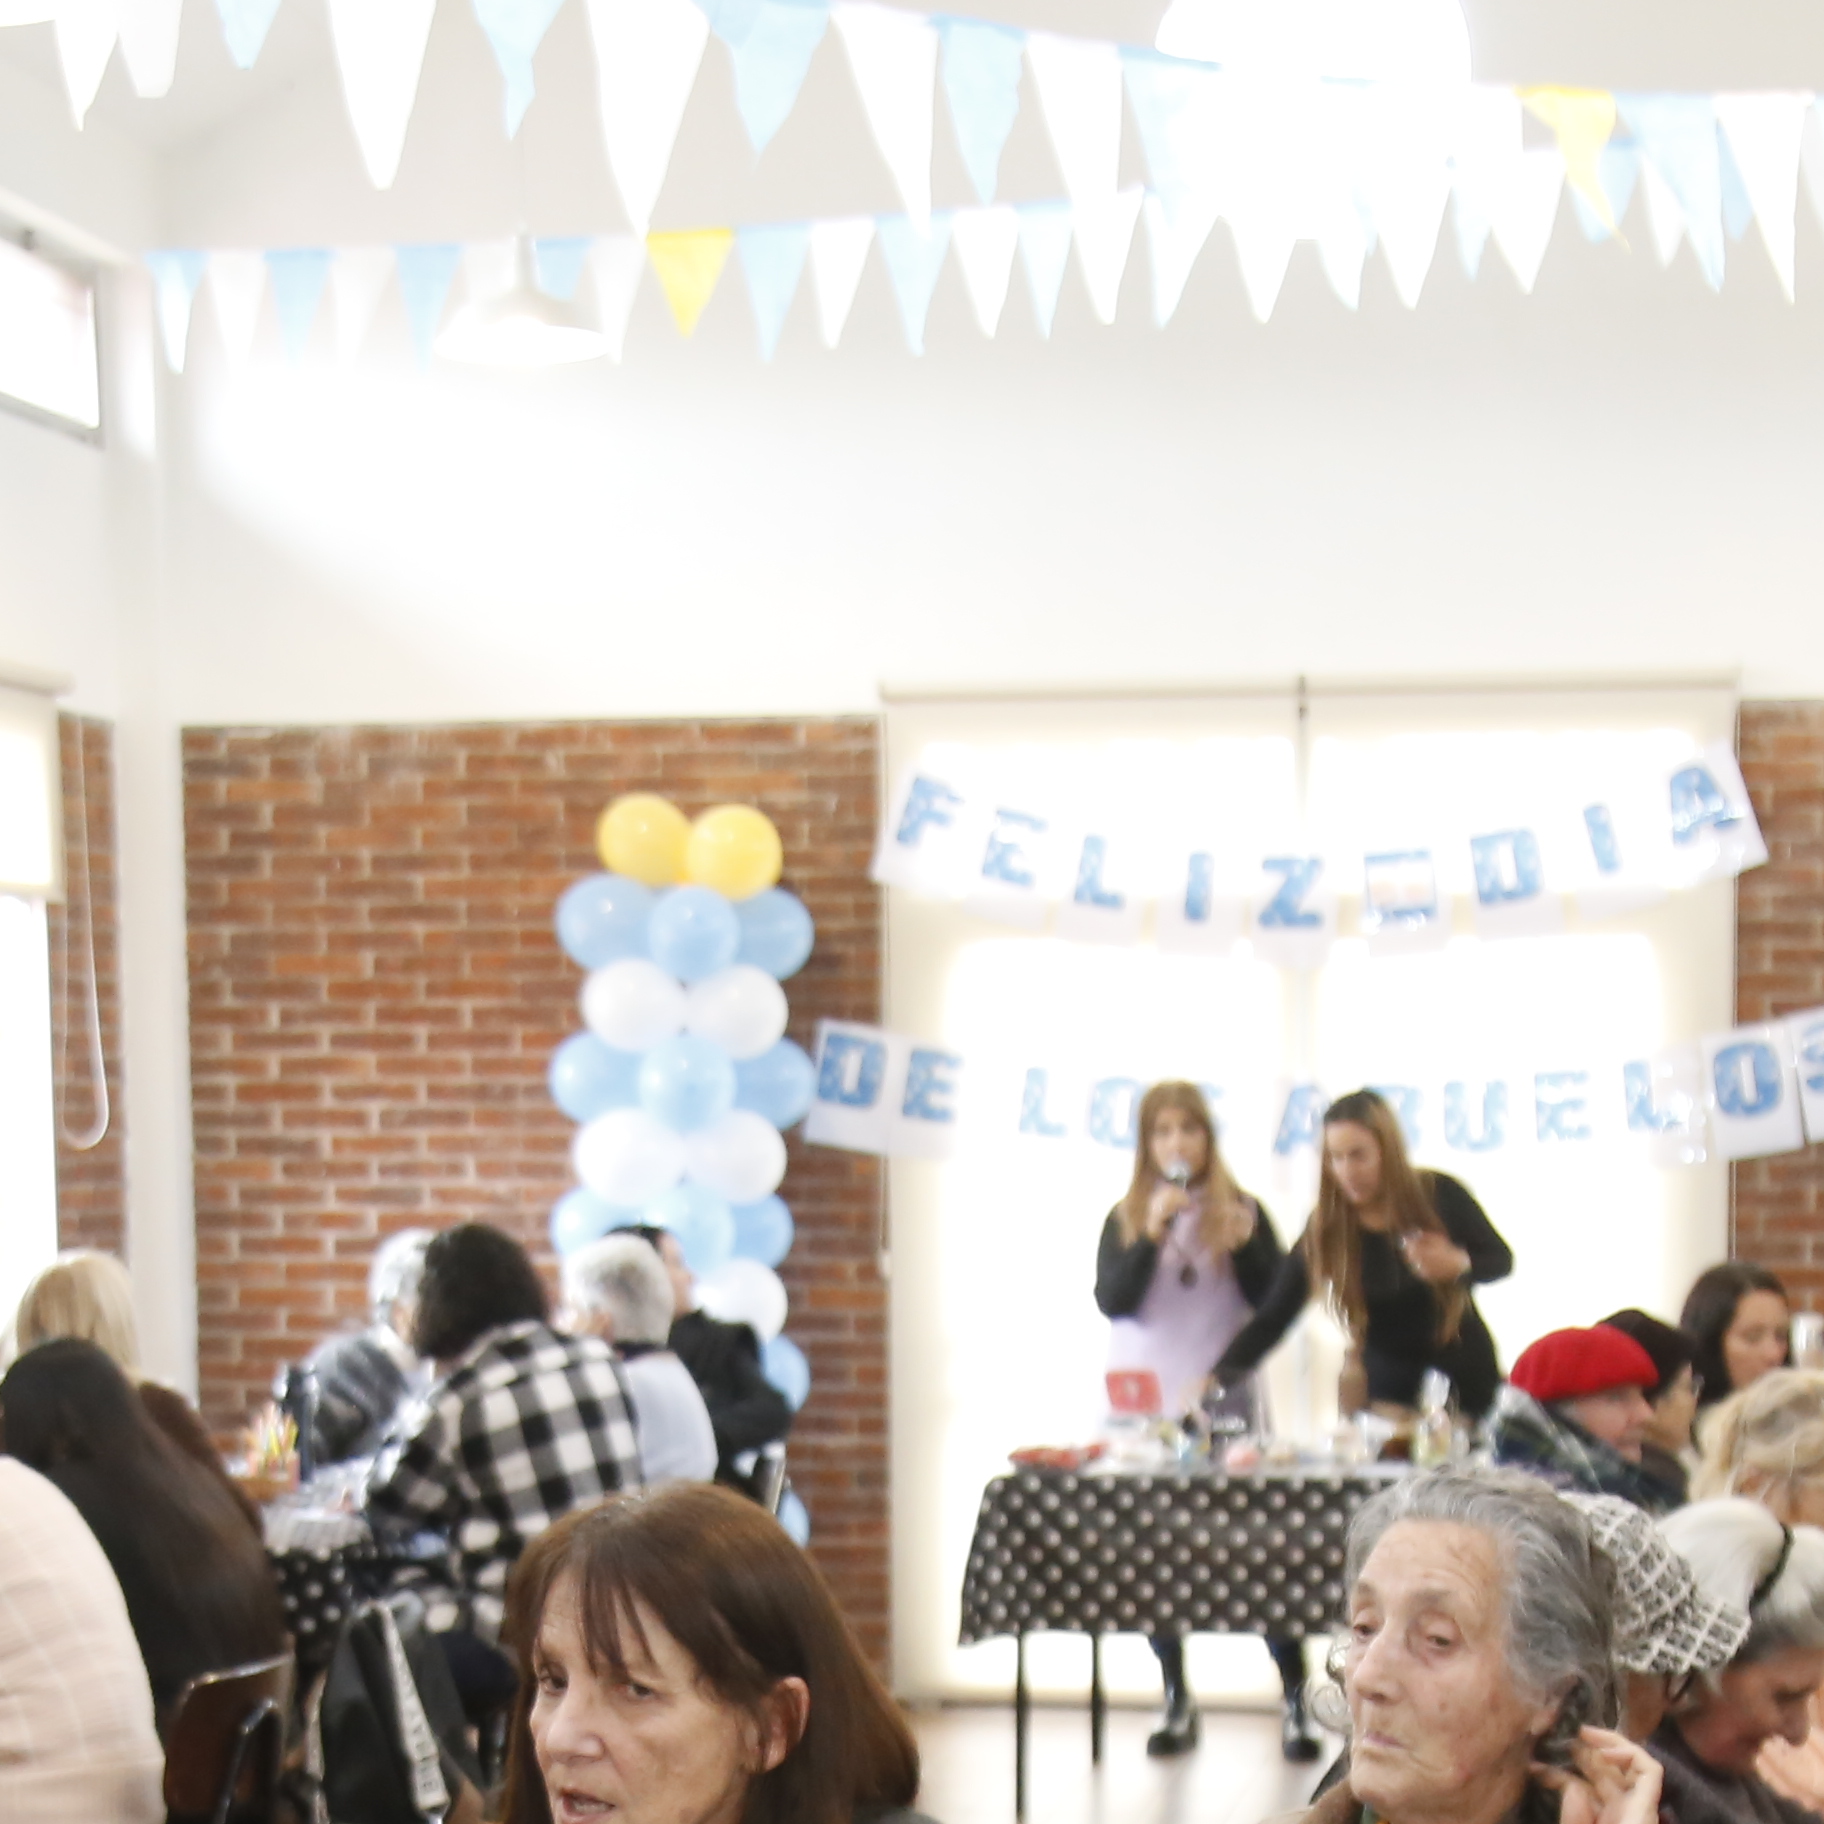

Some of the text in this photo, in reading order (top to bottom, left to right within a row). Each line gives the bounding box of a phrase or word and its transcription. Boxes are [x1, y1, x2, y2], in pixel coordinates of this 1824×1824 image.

[894, 765, 1742, 930] FELIZ DIA
[816, 1032, 964, 1124] DE
